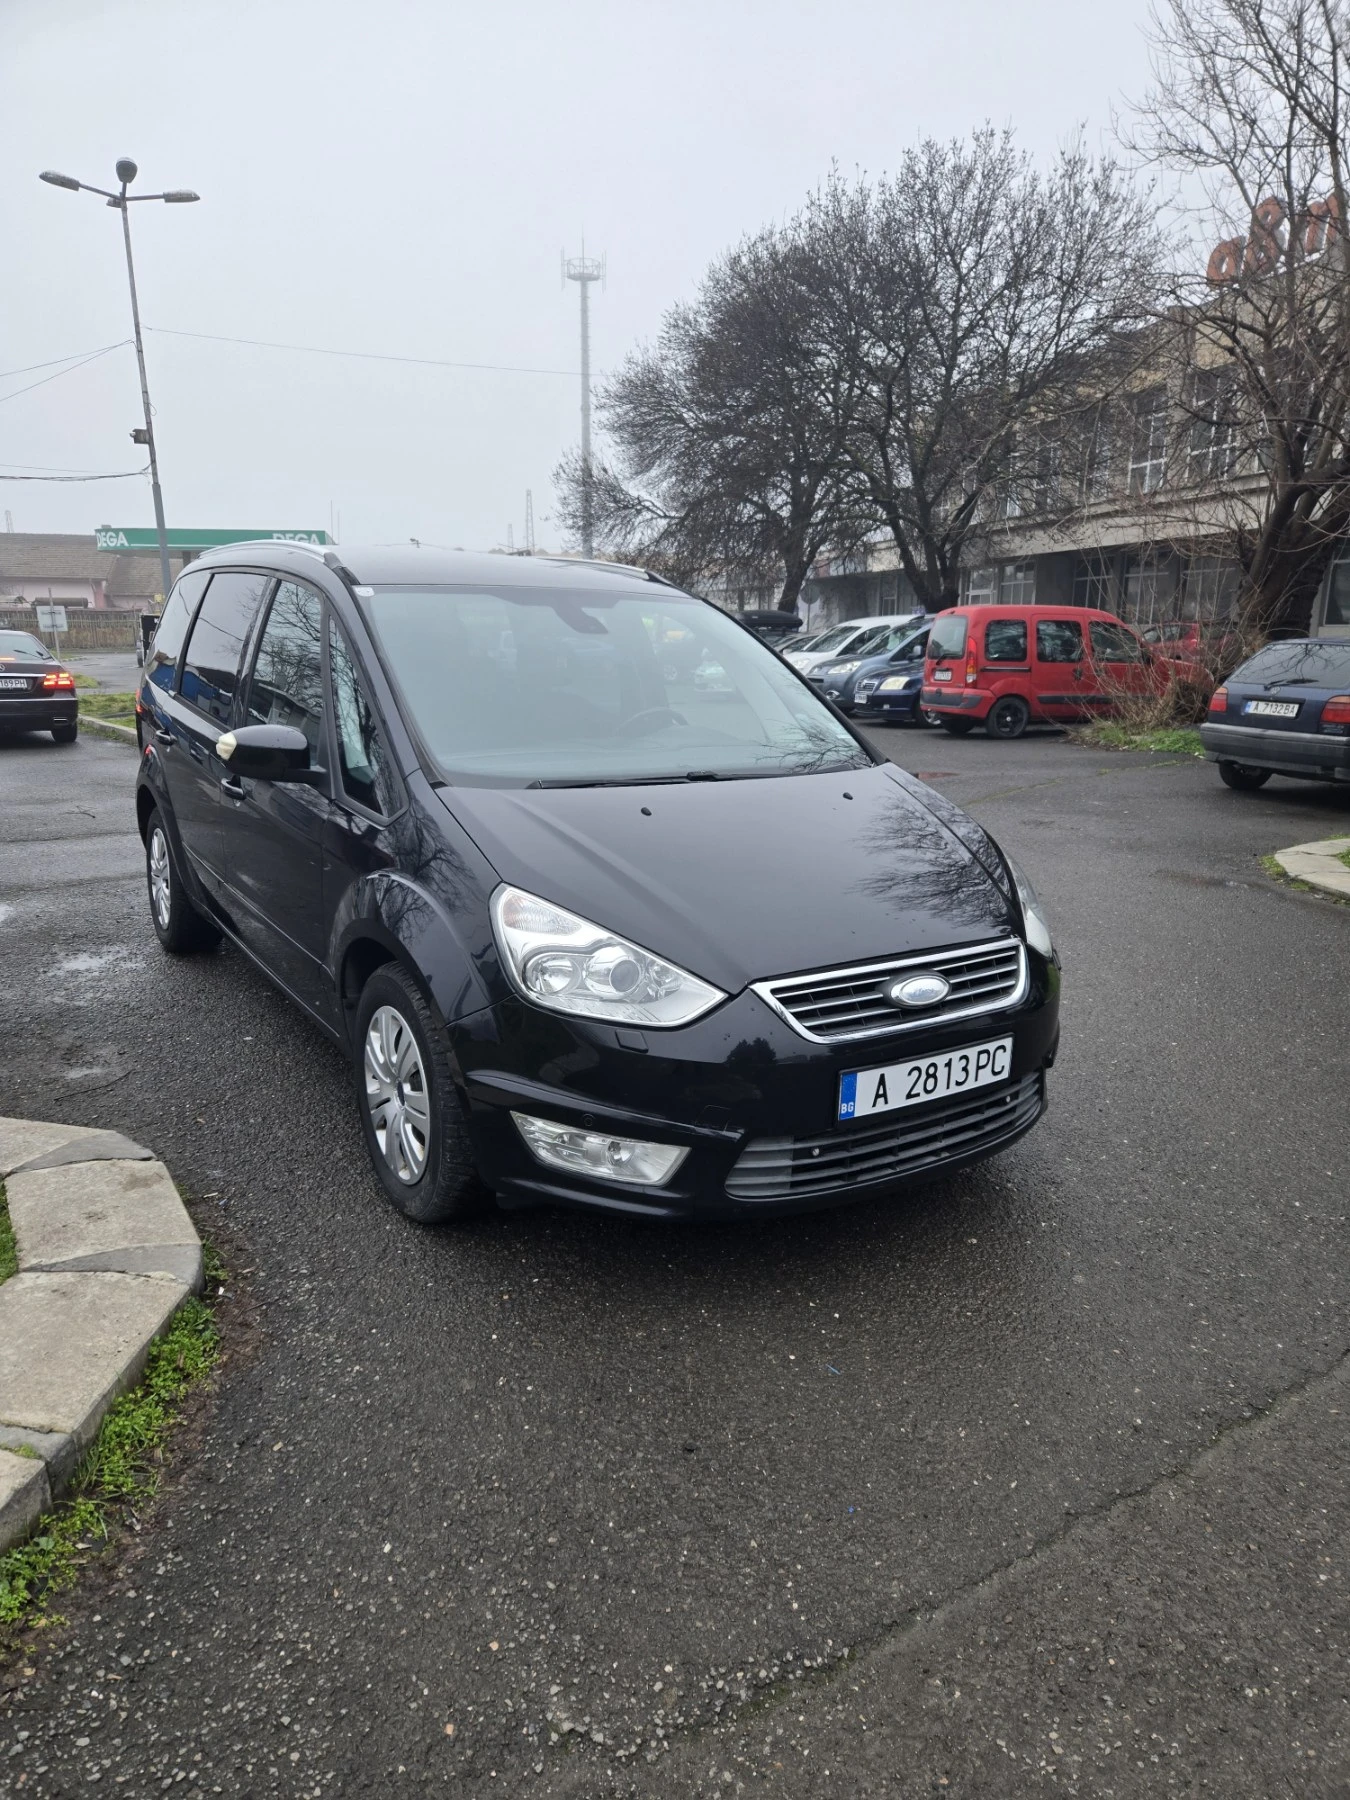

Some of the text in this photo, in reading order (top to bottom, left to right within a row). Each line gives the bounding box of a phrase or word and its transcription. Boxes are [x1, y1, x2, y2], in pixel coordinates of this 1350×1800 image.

[96, 531, 129, 547] DEGA
[871, 1073, 889, 1108] A
[840, 1102, 855, 1114] BG
